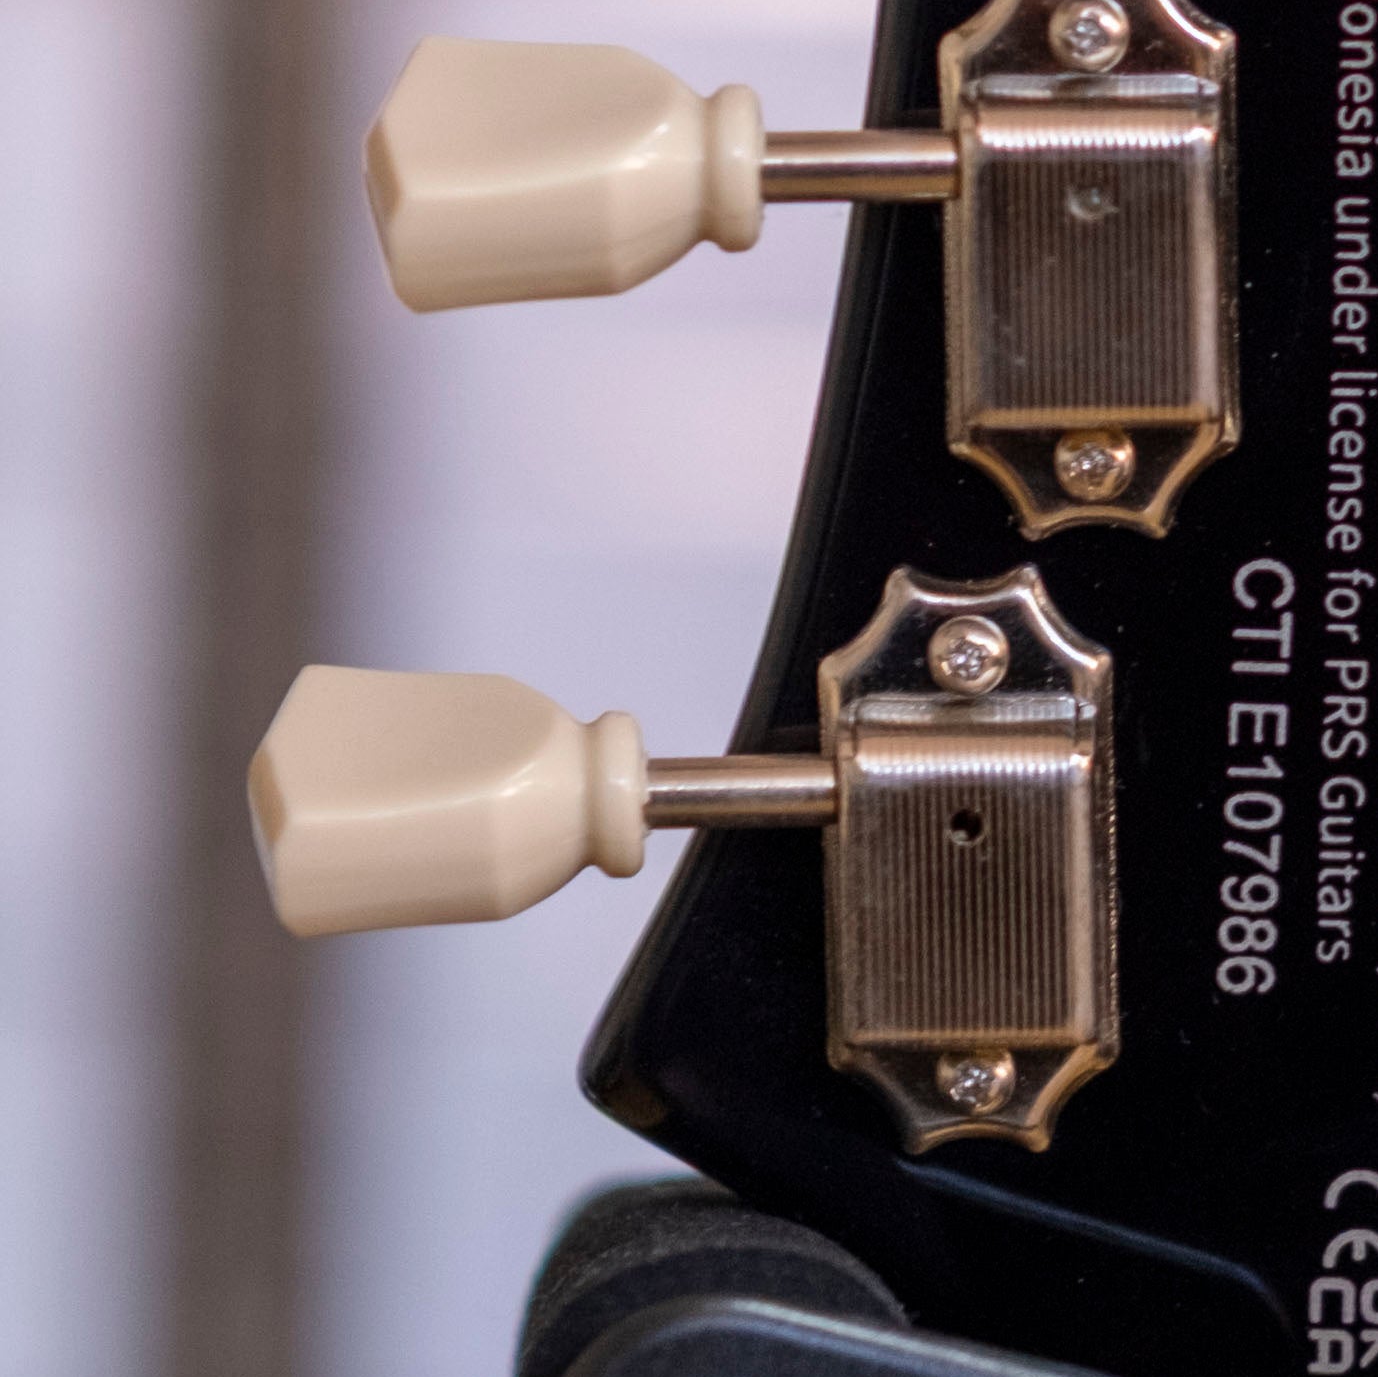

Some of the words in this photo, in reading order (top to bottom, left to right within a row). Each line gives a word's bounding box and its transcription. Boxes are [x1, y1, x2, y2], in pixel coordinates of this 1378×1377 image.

[1325, 371, 1378, 552] license
[1231, 557, 1296, 674] CTI
[1324, 568, 1376, 643] for
[1320, 659, 1369, 760] PRS
[1216, 701, 1289, 995] E107986
[1316, 775, 1367, 963] Guitars
